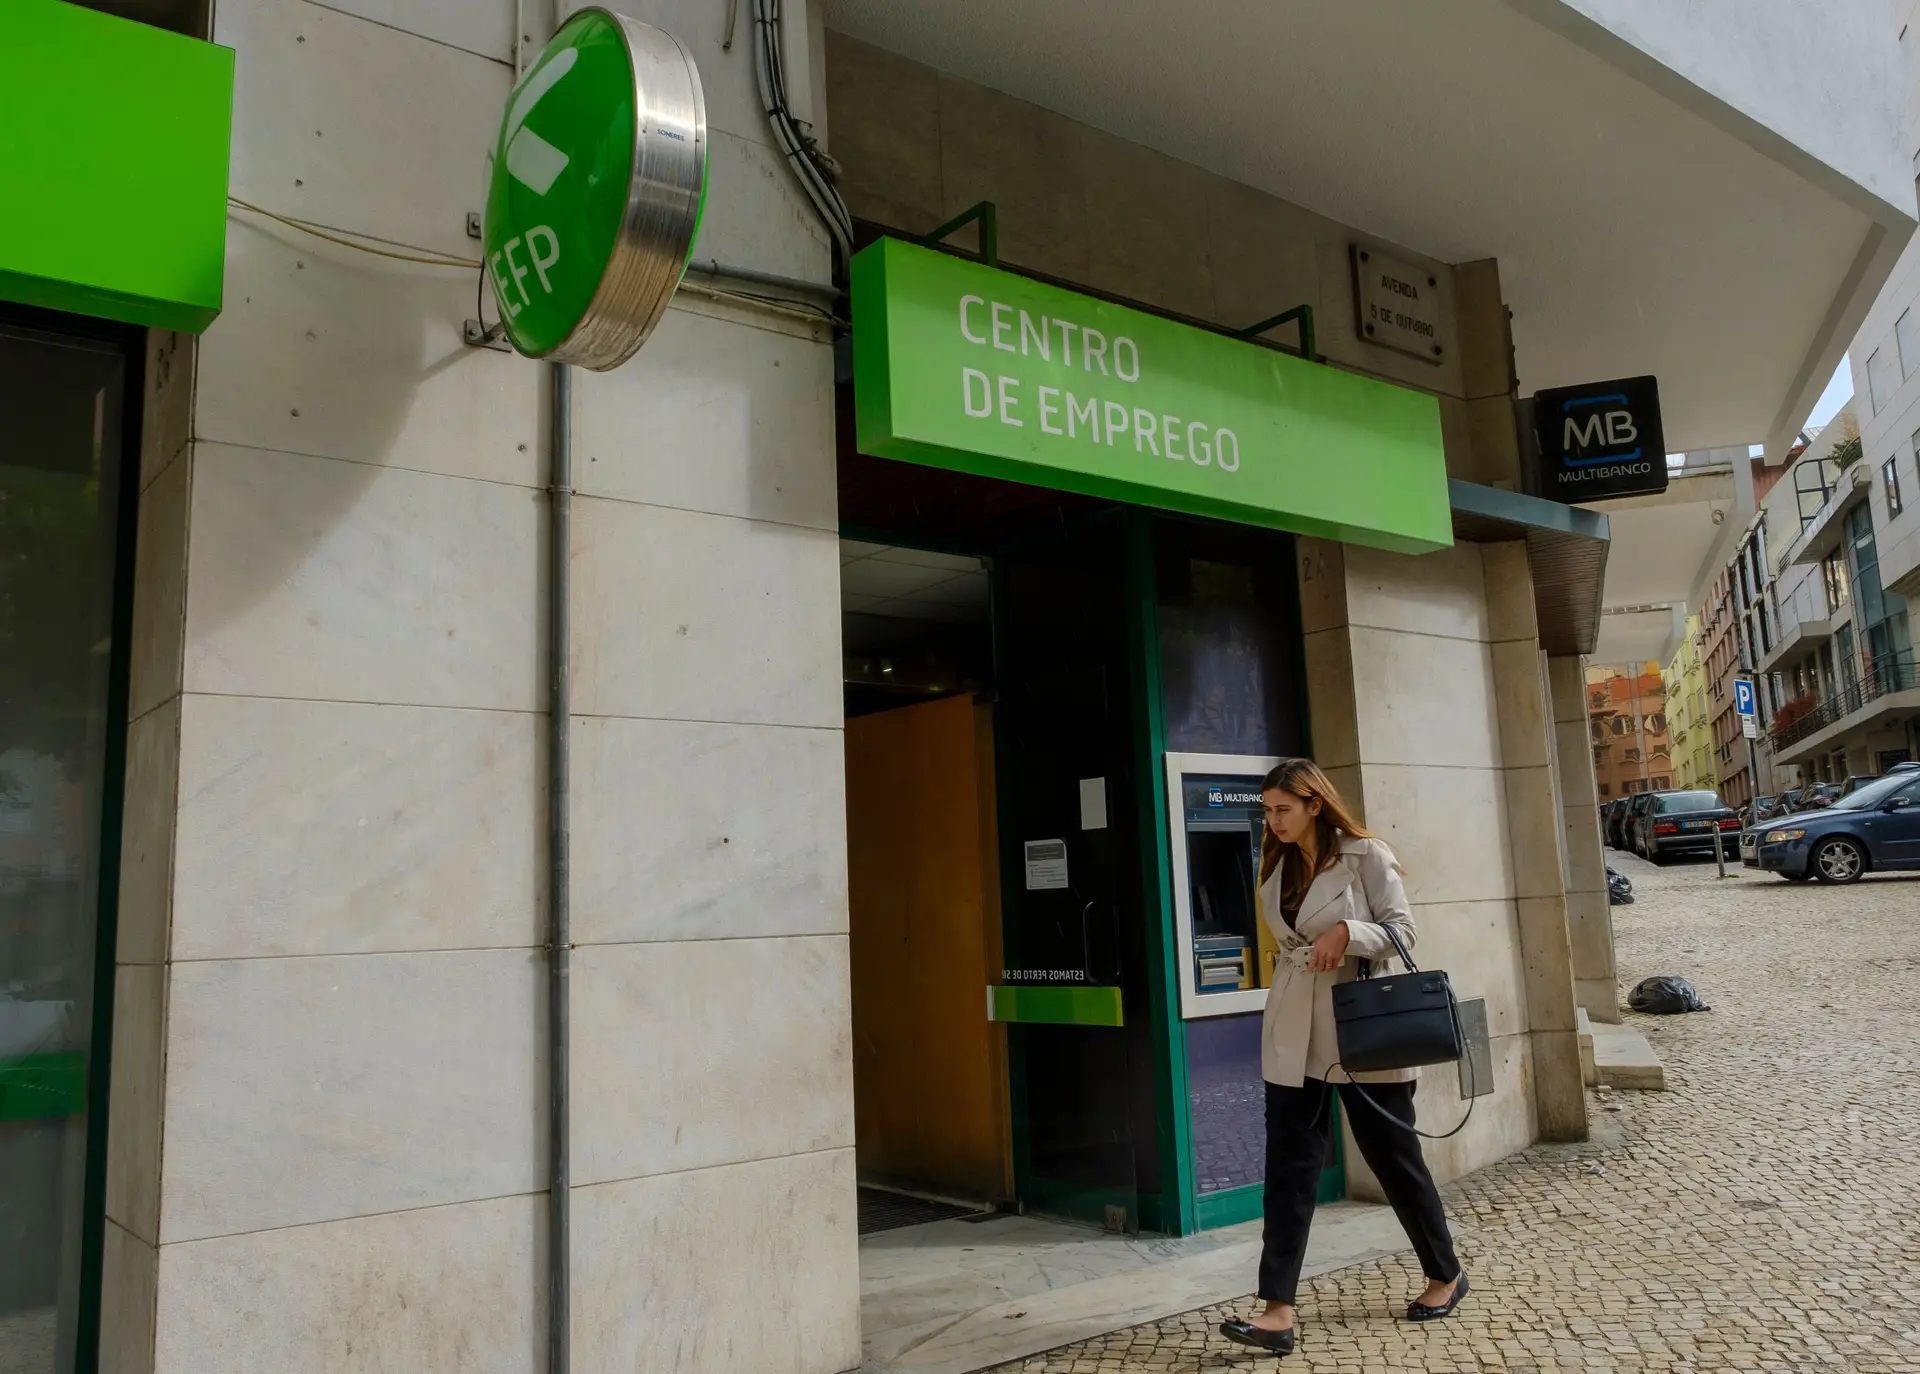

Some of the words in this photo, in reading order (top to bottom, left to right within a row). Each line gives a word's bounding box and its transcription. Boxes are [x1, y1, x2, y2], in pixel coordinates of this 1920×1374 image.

[1381, 275, 1418, 300] AVENIDA
[1371, 303, 1377, 319] 5
[1380, 308, 1392, 324] DE
[1396, 313, 1433, 338] OUTUBRO
[959, 294, 1139, 382] CENTRO
[963, 367, 1023, 427] DE
[1039, 386, 1240, 472] EMPREGO
[1563, 411, 1637, 450] MB
[1559, 463, 1650, 482] MULTIBANCO
[1739, 685, 1750, 710] P
[1209, 792, 1222, 802] MB
